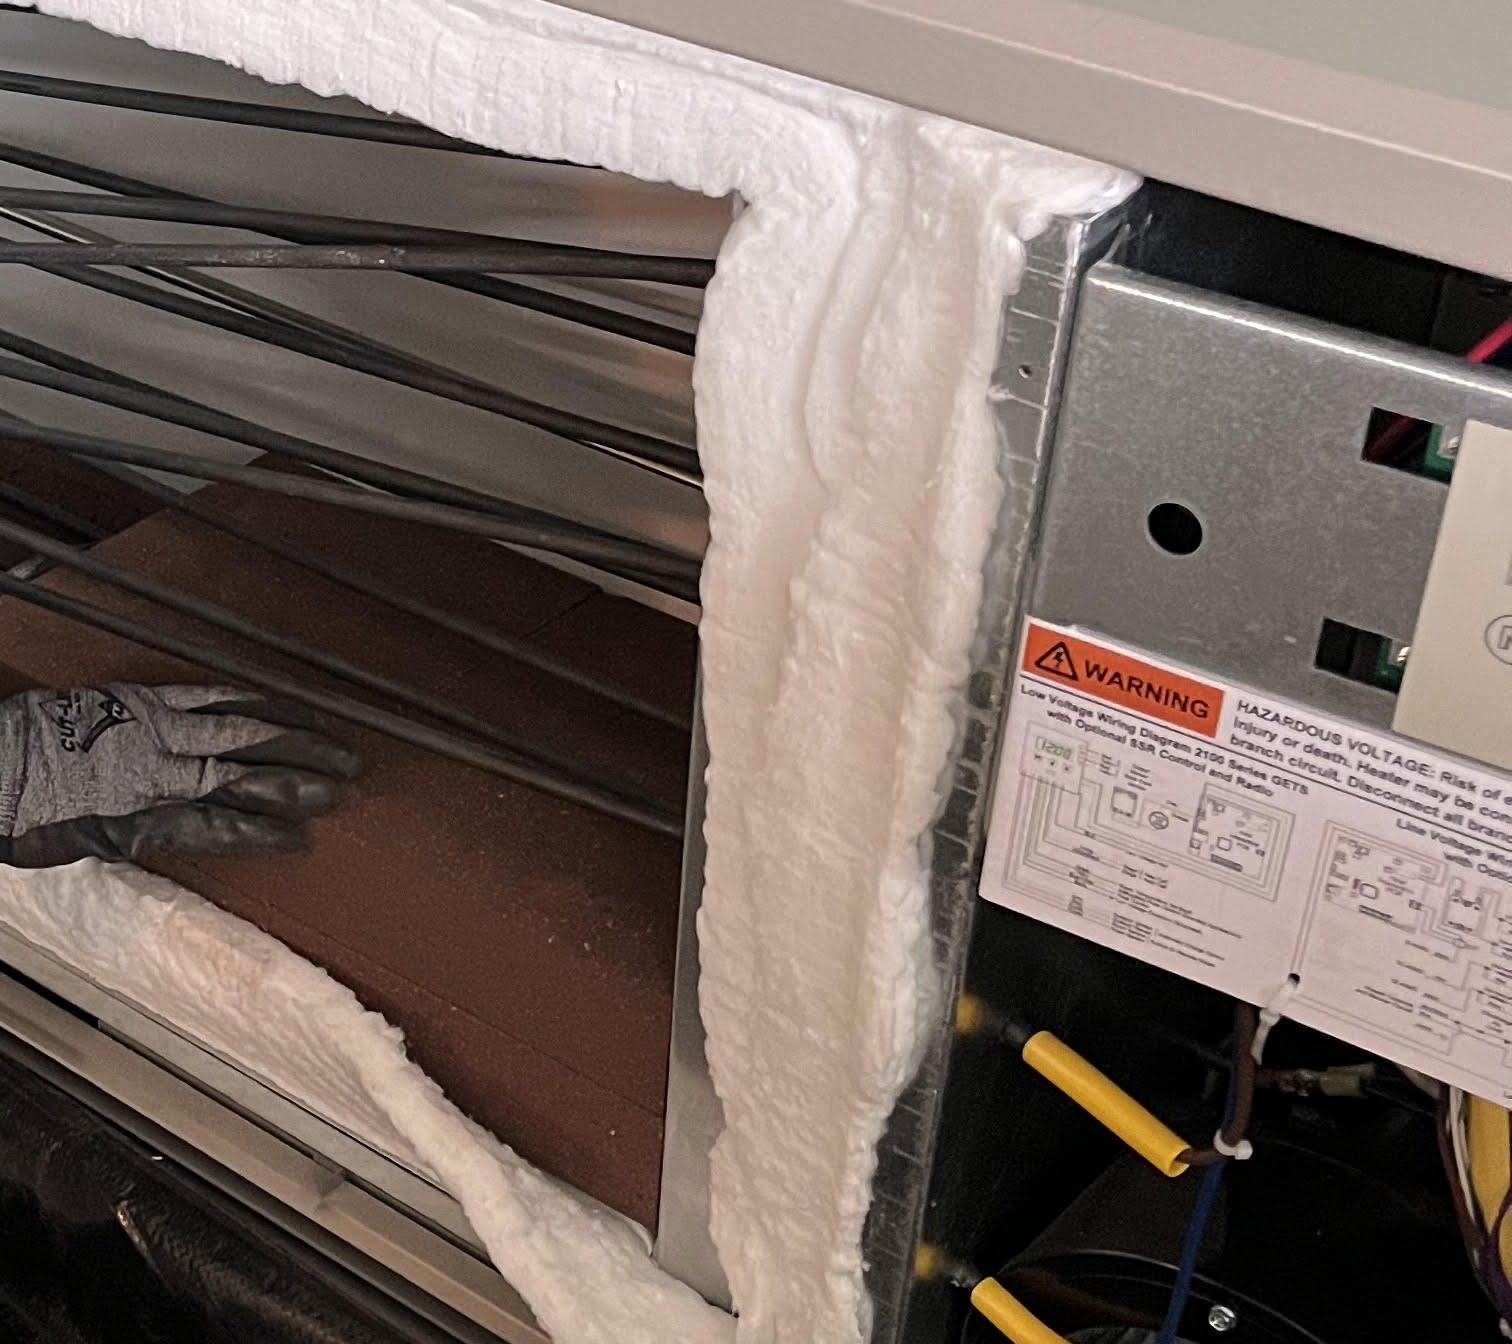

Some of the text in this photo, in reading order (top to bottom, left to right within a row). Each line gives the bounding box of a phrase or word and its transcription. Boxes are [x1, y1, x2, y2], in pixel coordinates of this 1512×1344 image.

[1020, 685, 1046, 702] Low
[1048, 695, 1094, 719] Voltage
[1095, 712, 1137, 734] Wiring
[1139, 727, 1192, 753] Diagram
[1227, 759, 1267, 780] Series
[1081, 660, 1210, 719] WARNING
[1046, 708, 1072, 724] with
[1074, 719, 1125, 743] Optional
[1159, 749, 1206, 772] Control
[1209, 767, 1232, 781] and
[1235, 776, 1275, 796] Radio
[1229, 734, 1285, 762] branch
[1347, 776, 1440, 817] Disconnect
[1443, 810, 1463, 825] all
[1237, 700, 1504, 802] HAZARDOUS VOLTAGE: Risk of
[1281, 735, 1299, 749] or
[1356, 762, 1410, 789] Heater
[1413, 782, 1449, 803] may
[1453, 796, 1474, 812] be
